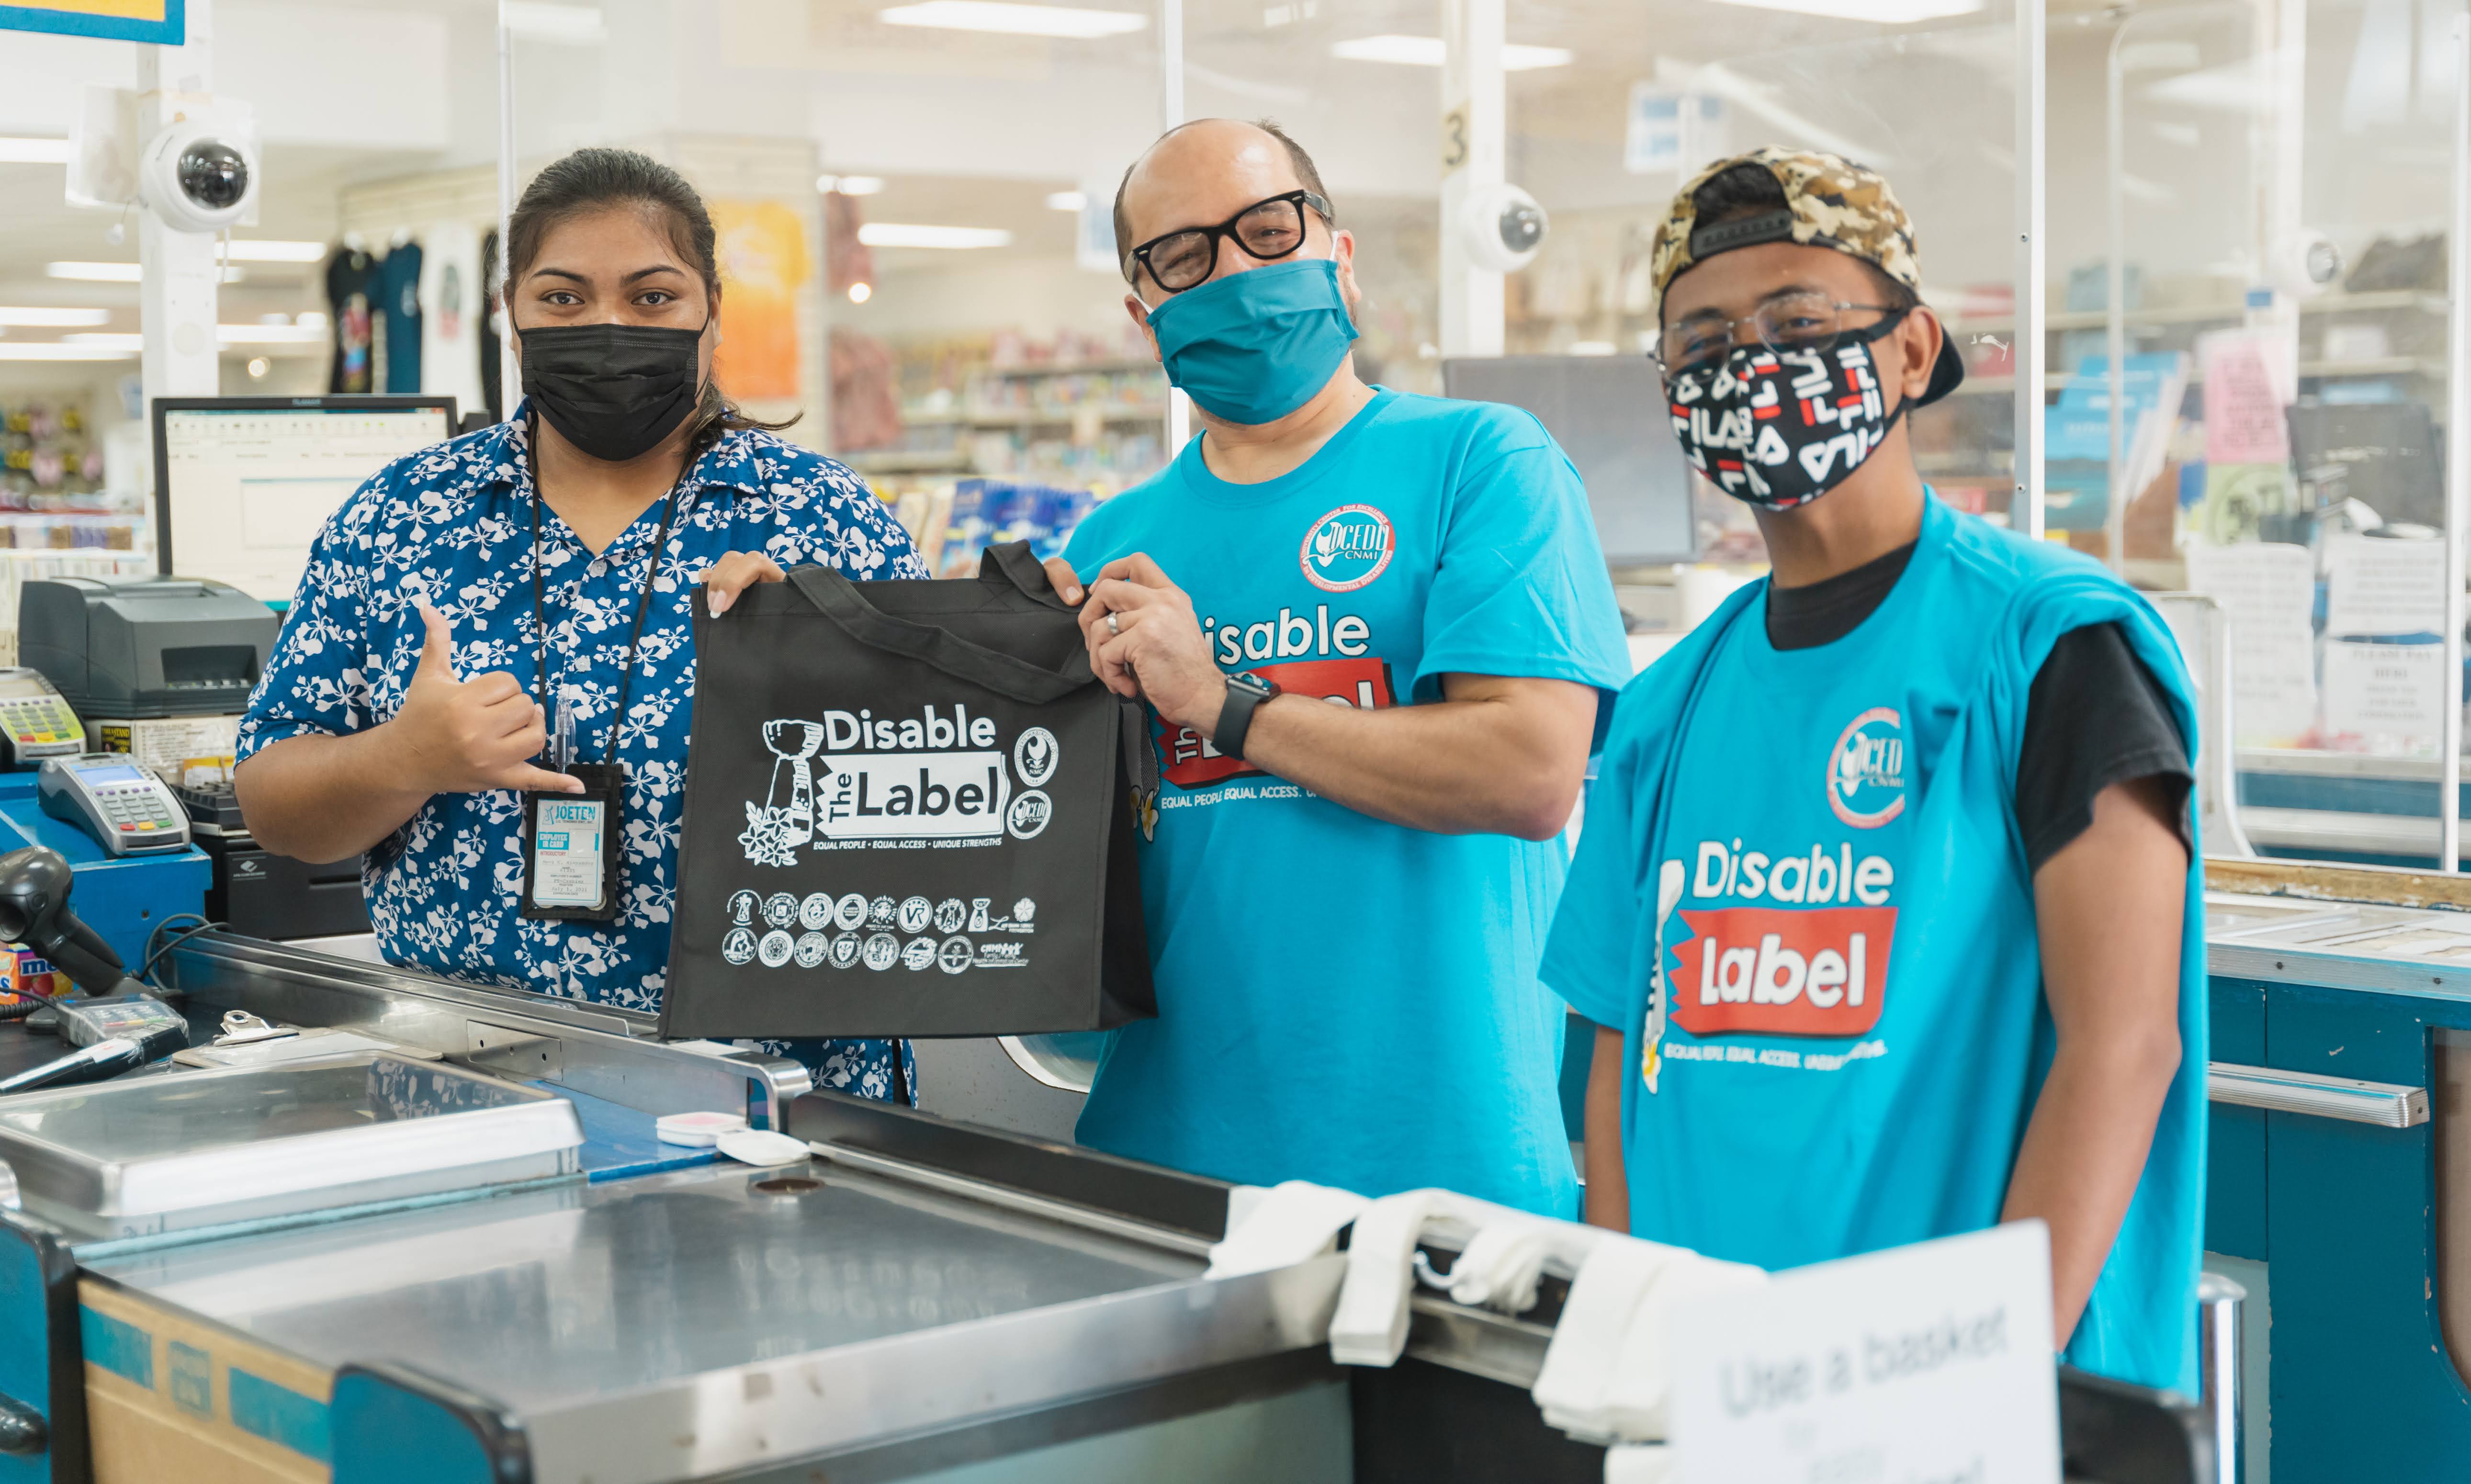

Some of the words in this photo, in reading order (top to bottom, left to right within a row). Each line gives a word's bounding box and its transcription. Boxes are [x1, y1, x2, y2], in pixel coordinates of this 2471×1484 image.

[1445, 111, 1467, 166] 3
[1318, 507, 1341, 525] CENTER
[1357, 504, 1389, 525] EXCELLENCE
[1344, 551, 1378, 560] CNMI
[1308, 573, 1361, 591] DEVELOPMENTAL
[1203, 604, 1369, 664] isable
[824, 704, 996, 750] Disable
[1174, 727, 1198, 764] Th
[829, 773, 852, 823] The
[857, 767, 997, 817] Label
[1161, 796, 1192, 809] EQUAL
[1194, 791, 1223, 807] PEOPLE
[1224, 787, 1257, 800] EQUAL
[1260, 787, 1302, 798] ACCESS.
[555, 805, 596, 820] JOETEN
[813, 841, 837, 850] EQUAL
[839, 840, 866, 849] PEOPLE
[872, 840, 897, 849] EQUAL
[898, 840, 926, 849] ACCESS
[933, 839, 961, 848] UNIQUE
[961, 837, 1003, 847] STRENGTHS
[1692, 837, 1895, 905] Disable
[906, 908, 925, 924] VR
[1719, 1352, 1813, 1419] Use
[1825, 1346, 1852, 1395] a
[1863, 1303, 2009, 1384] basket
